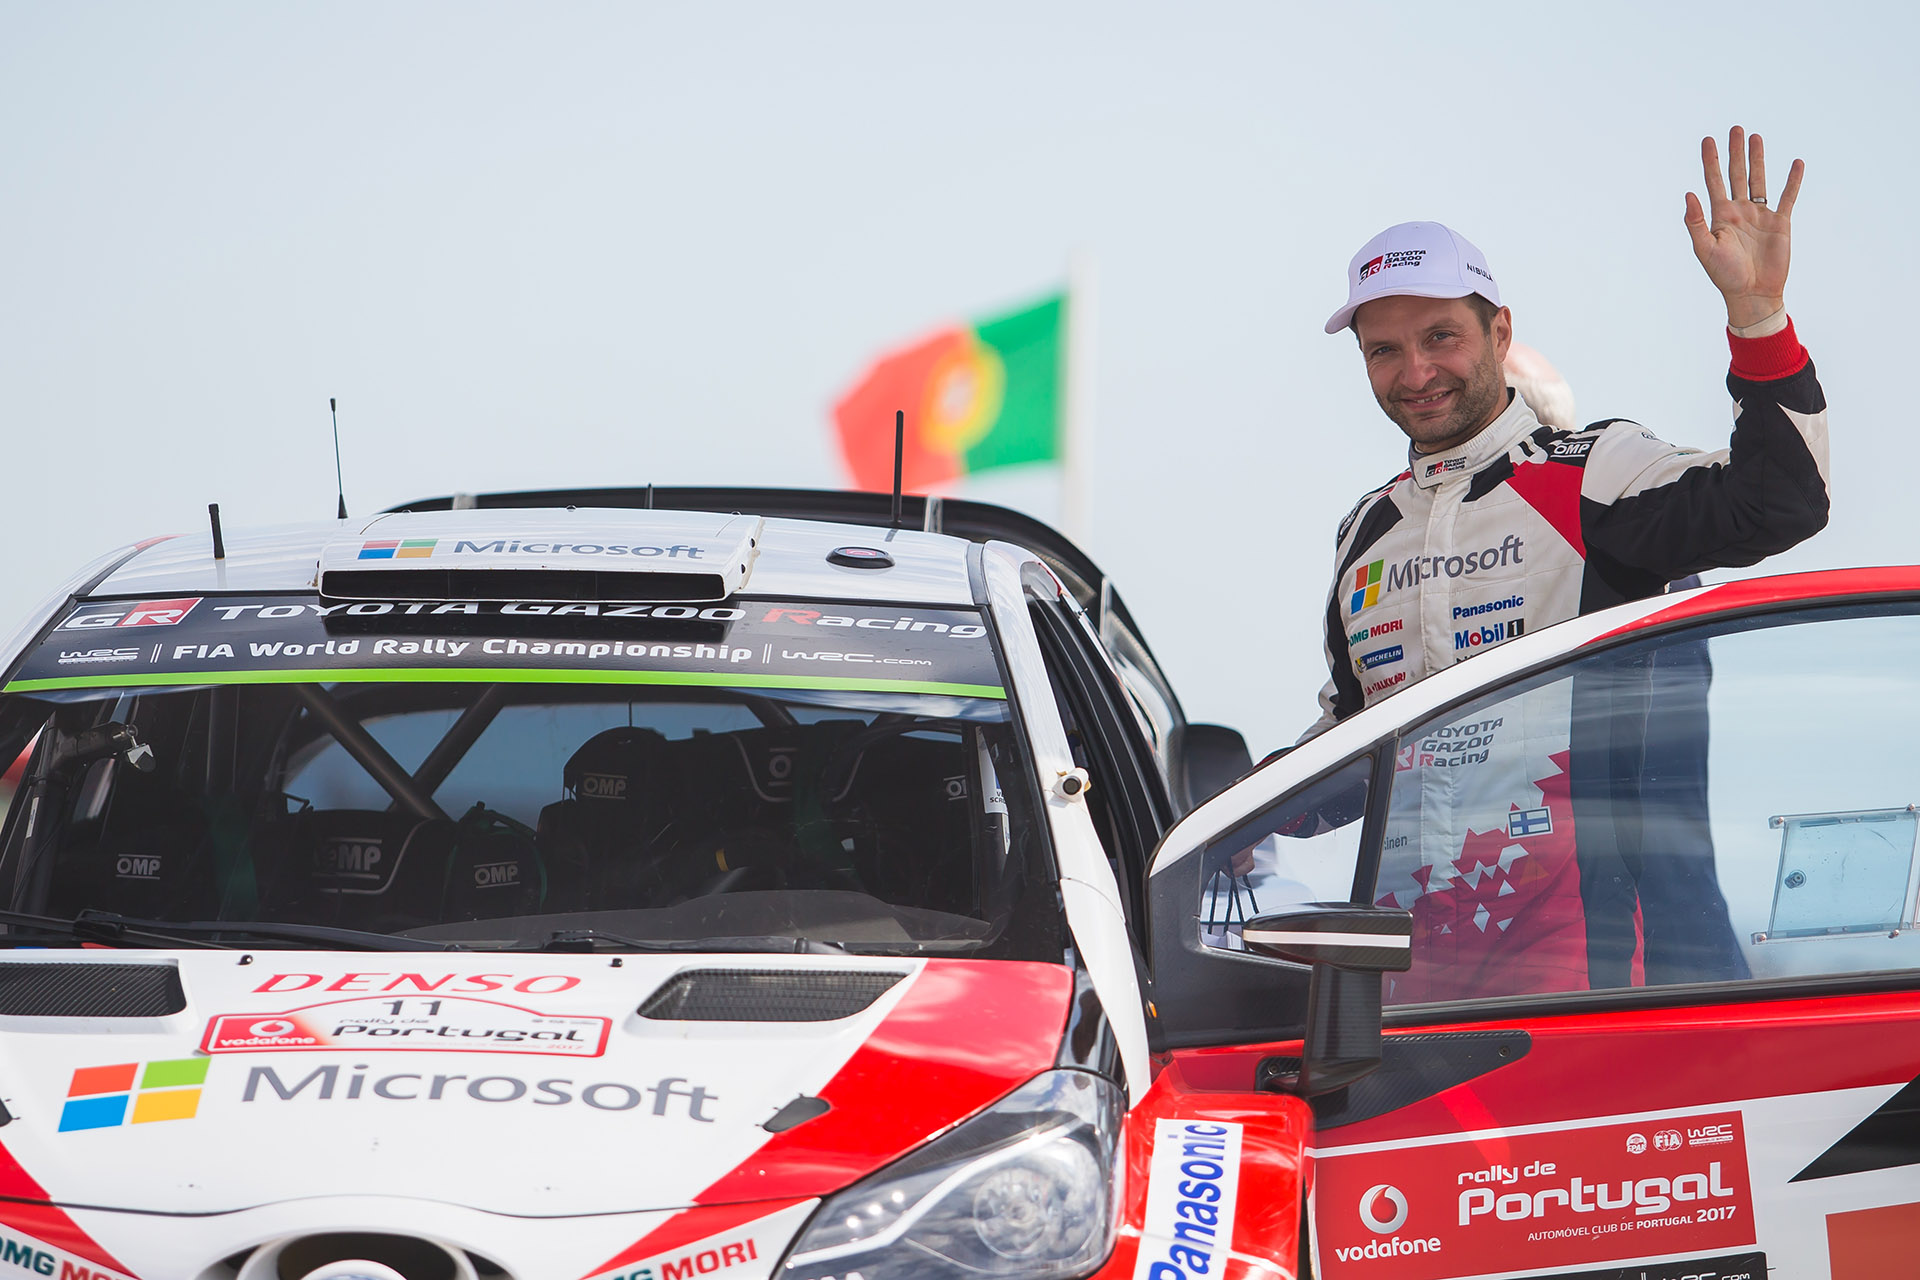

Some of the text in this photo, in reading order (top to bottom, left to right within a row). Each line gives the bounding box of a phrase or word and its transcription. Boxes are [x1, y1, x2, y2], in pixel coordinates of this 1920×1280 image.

[1384, 255, 1422, 264] GAZOO
[1385, 250, 1427, 258] TOYOTA
[1383, 261, 1421, 270] Racing
[1553, 443, 1590, 454] OMP
[453, 540, 705, 560] Microsoft
[1387, 534, 1524, 592] Microsoft
[1453, 595, 1524, 619] Panasonic
[62, 602, 987, 638] GR TOYOTA GAZOO Racing
[1370, 619, 1404, 638] MORI
[1454, 622, 1504, 650] Mobil
[60, 648, 141, 658] WRC
[173, 639, 752, 663] FIA World Rally Championship
[781, 650, 932, 666] WRC.com
[1366, 649, 1402, 664] MICHELIN
[1428, 718, 1504, 738] OYOTA
[1421, 734, 1494, 753] GAZOO
[1419, 749, 1490, 767] Racing
[583, 775, 627, 797] OMP
[116, 856, 161, 876] OMP
[474, 863, 518, 887] OMP
[251, 972, 582, 994] DENSO
[382, 1000, 442, 1016] 11
[220, 1036, 316, 1047] vodafone
[332, 1024, 585, 1042] Portugal
[242, 1063, 719, 1123] Microsoft
[1687, 1123, 1733, 1138] WRC
[1458, 1161, 1556, 1185] rally de
[1149, 1124, 1228, 1280] Panasonic
[1458, 1161, 1734, 1226] Portugal
[1527, 1205, 1737, 1242] AUTOMÓVEL CLUB DE PORTUGAL 2017
[661, 1238, 758, 1280] MORI
[1335, 1236, 1442, 1263] vodafone
